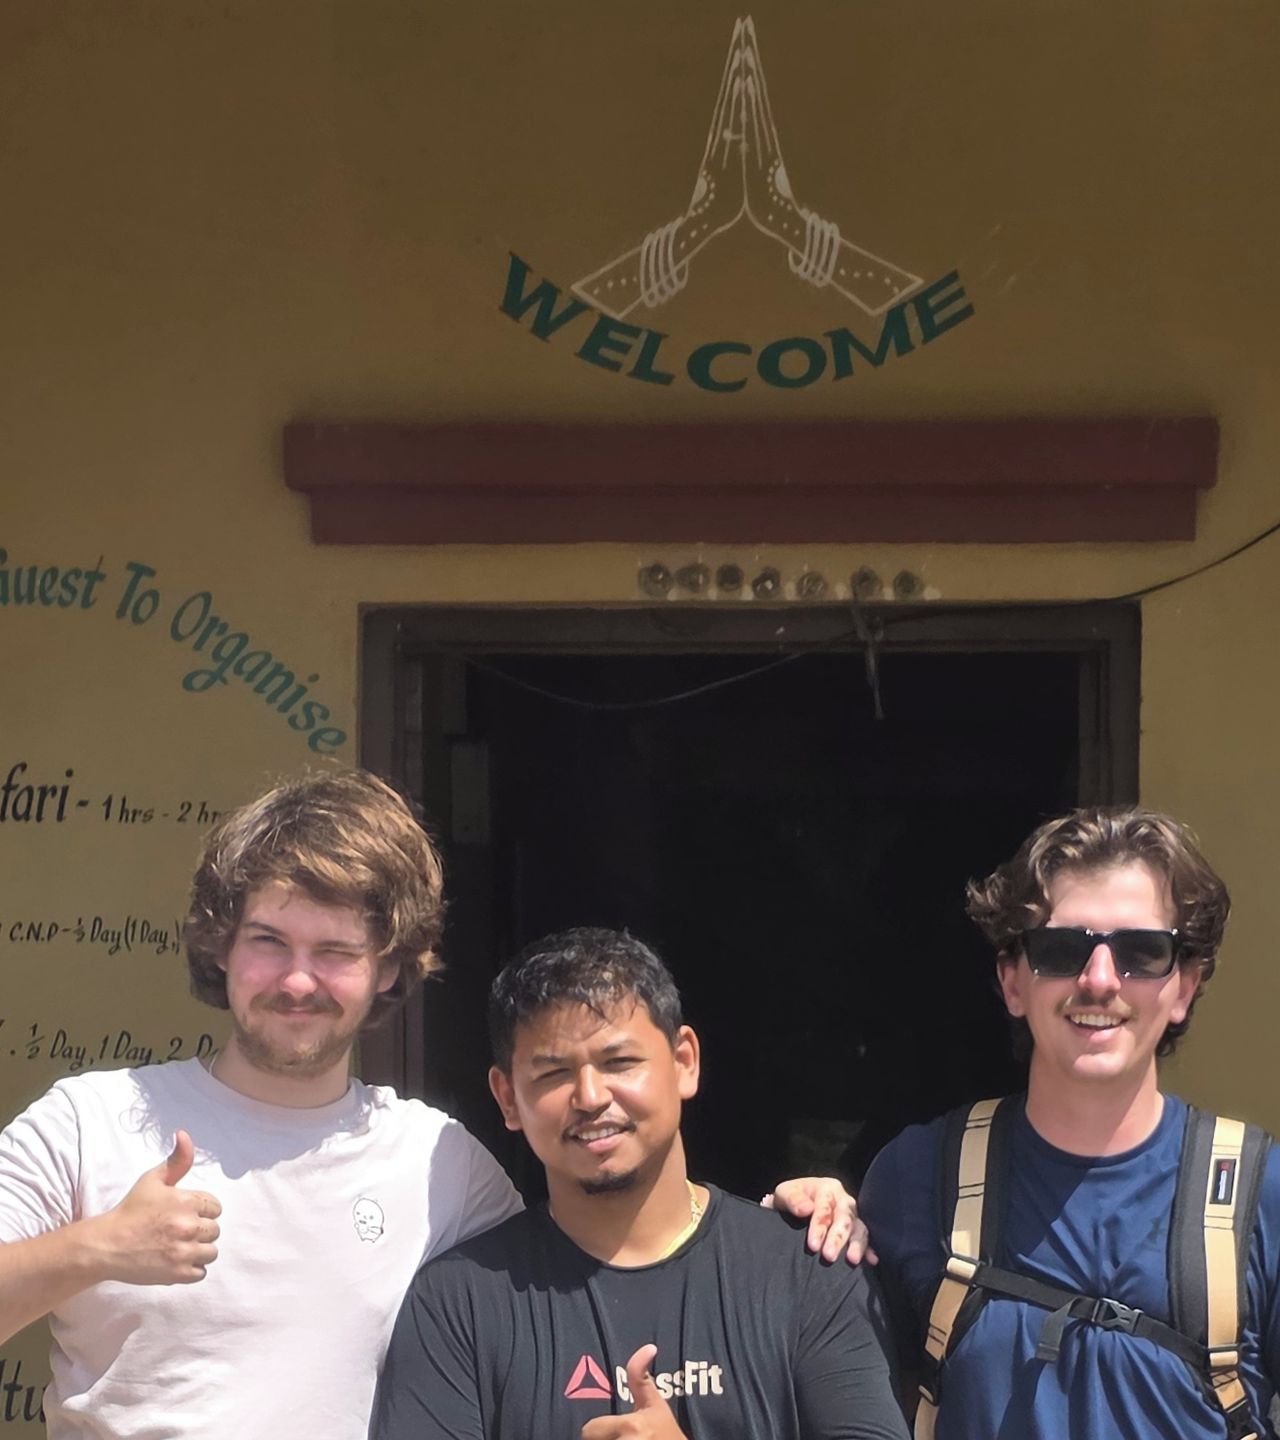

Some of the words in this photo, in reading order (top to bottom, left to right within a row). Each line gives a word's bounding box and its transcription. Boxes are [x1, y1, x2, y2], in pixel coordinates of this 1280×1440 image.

[499, 251, 975, 393] WELCOME
[114, 562, 161, 625] To
[170, 591, 349, 755] Organise
[177, 801, 192, 823] 2
[166, 1036, 183, 1061] 2
